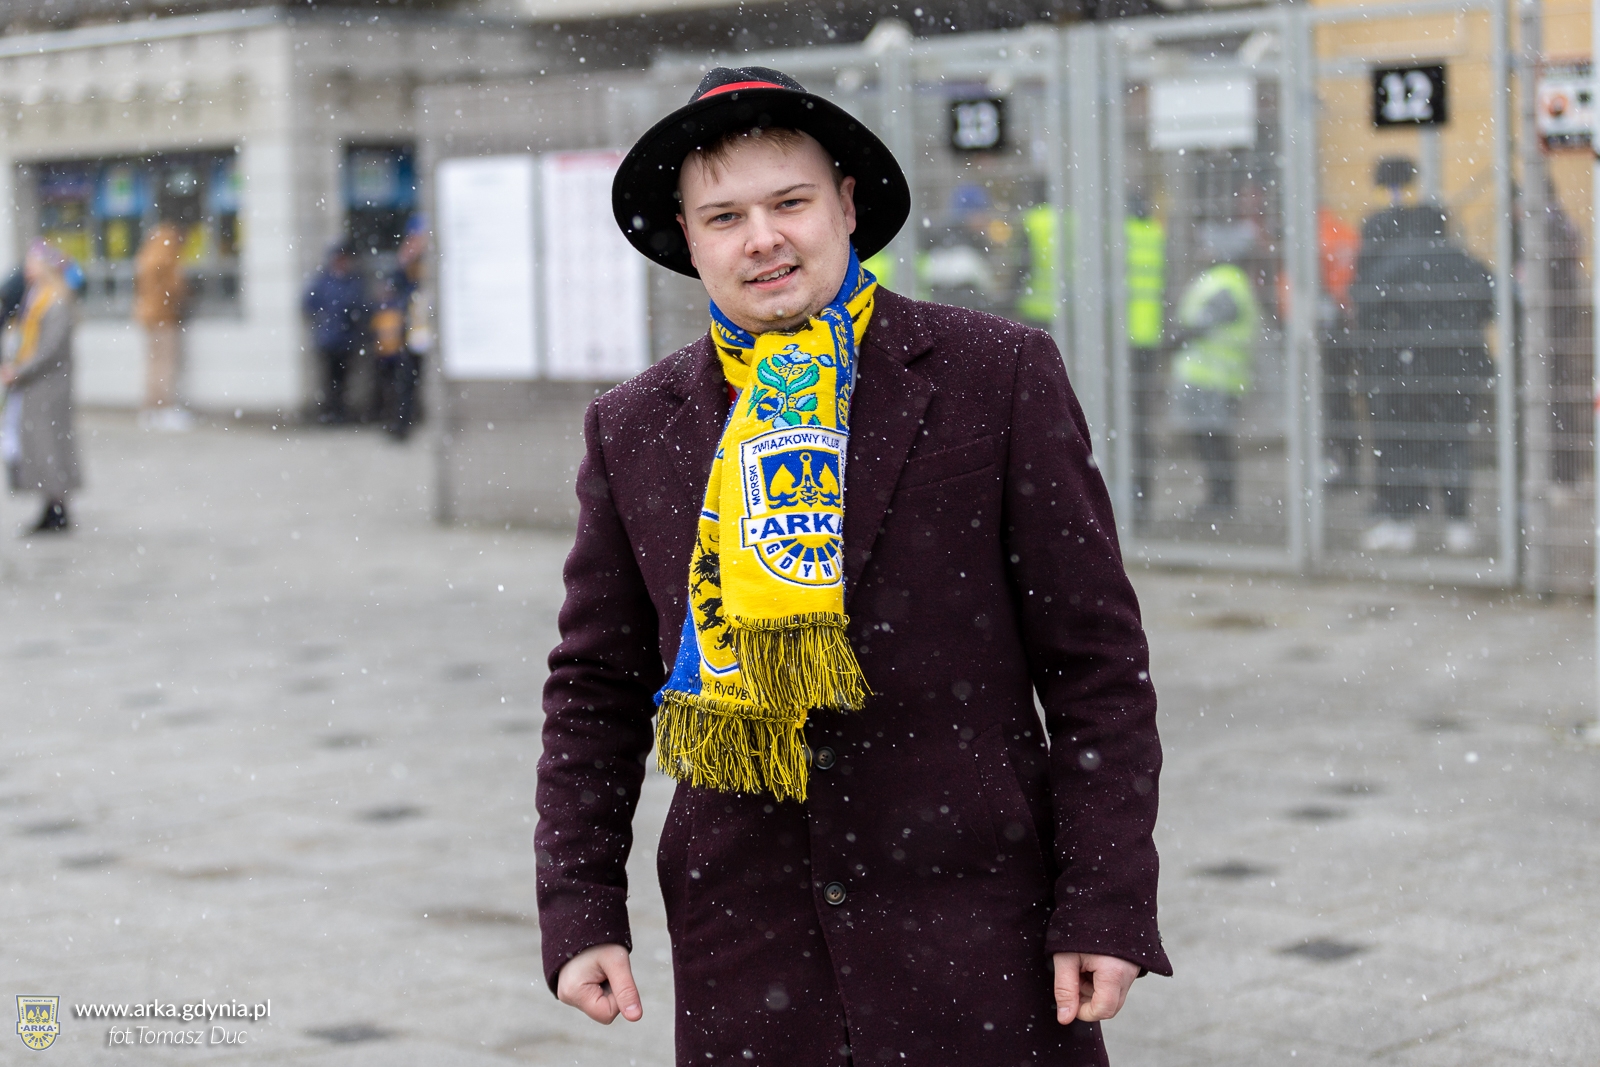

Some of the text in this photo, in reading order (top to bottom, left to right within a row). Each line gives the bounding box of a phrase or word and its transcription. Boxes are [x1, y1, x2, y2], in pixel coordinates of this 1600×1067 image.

[1381, 70, 1433, 121] 12
[953, 102, 999, 148] 13
[752, 433, 840, 455] ZWIĄZKOWY KLUB
[749, 465, 762, 506] MORSKI
[766, 540, 842, 577] GDYNI
